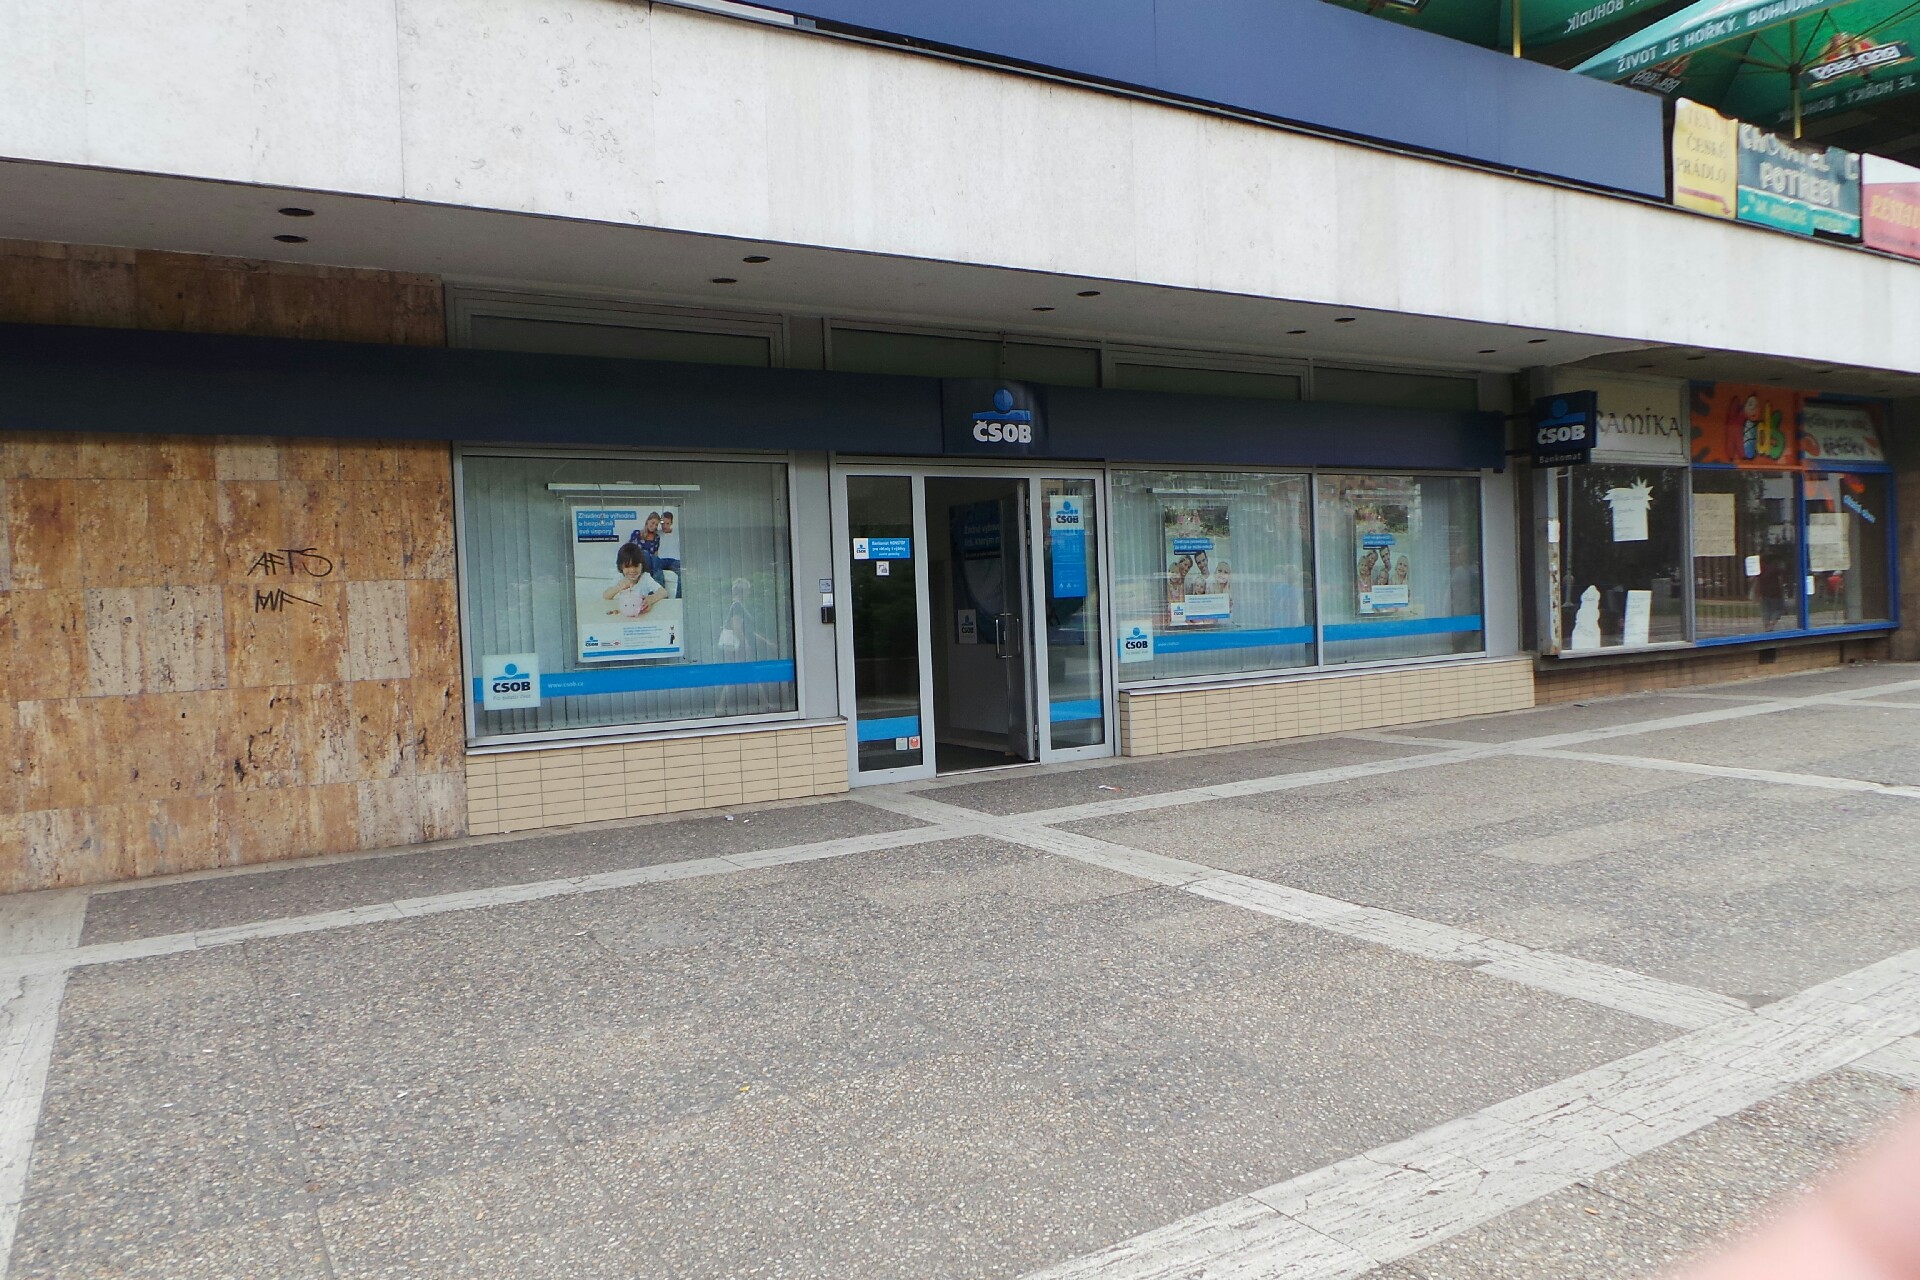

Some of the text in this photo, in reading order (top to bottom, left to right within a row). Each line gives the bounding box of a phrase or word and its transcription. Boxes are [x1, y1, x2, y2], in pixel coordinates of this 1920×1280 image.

[1617, 48, 1657, 75] ŽIVOT
[1661, 38, 1681, 58] JE
[973, 419, 1032, 444] ČSOB
[1537, 424, 1586, 445] ČSOB
[1125, 640, 1149, 649] ČSOB
[492, 681, 531, 693] ČSOB
